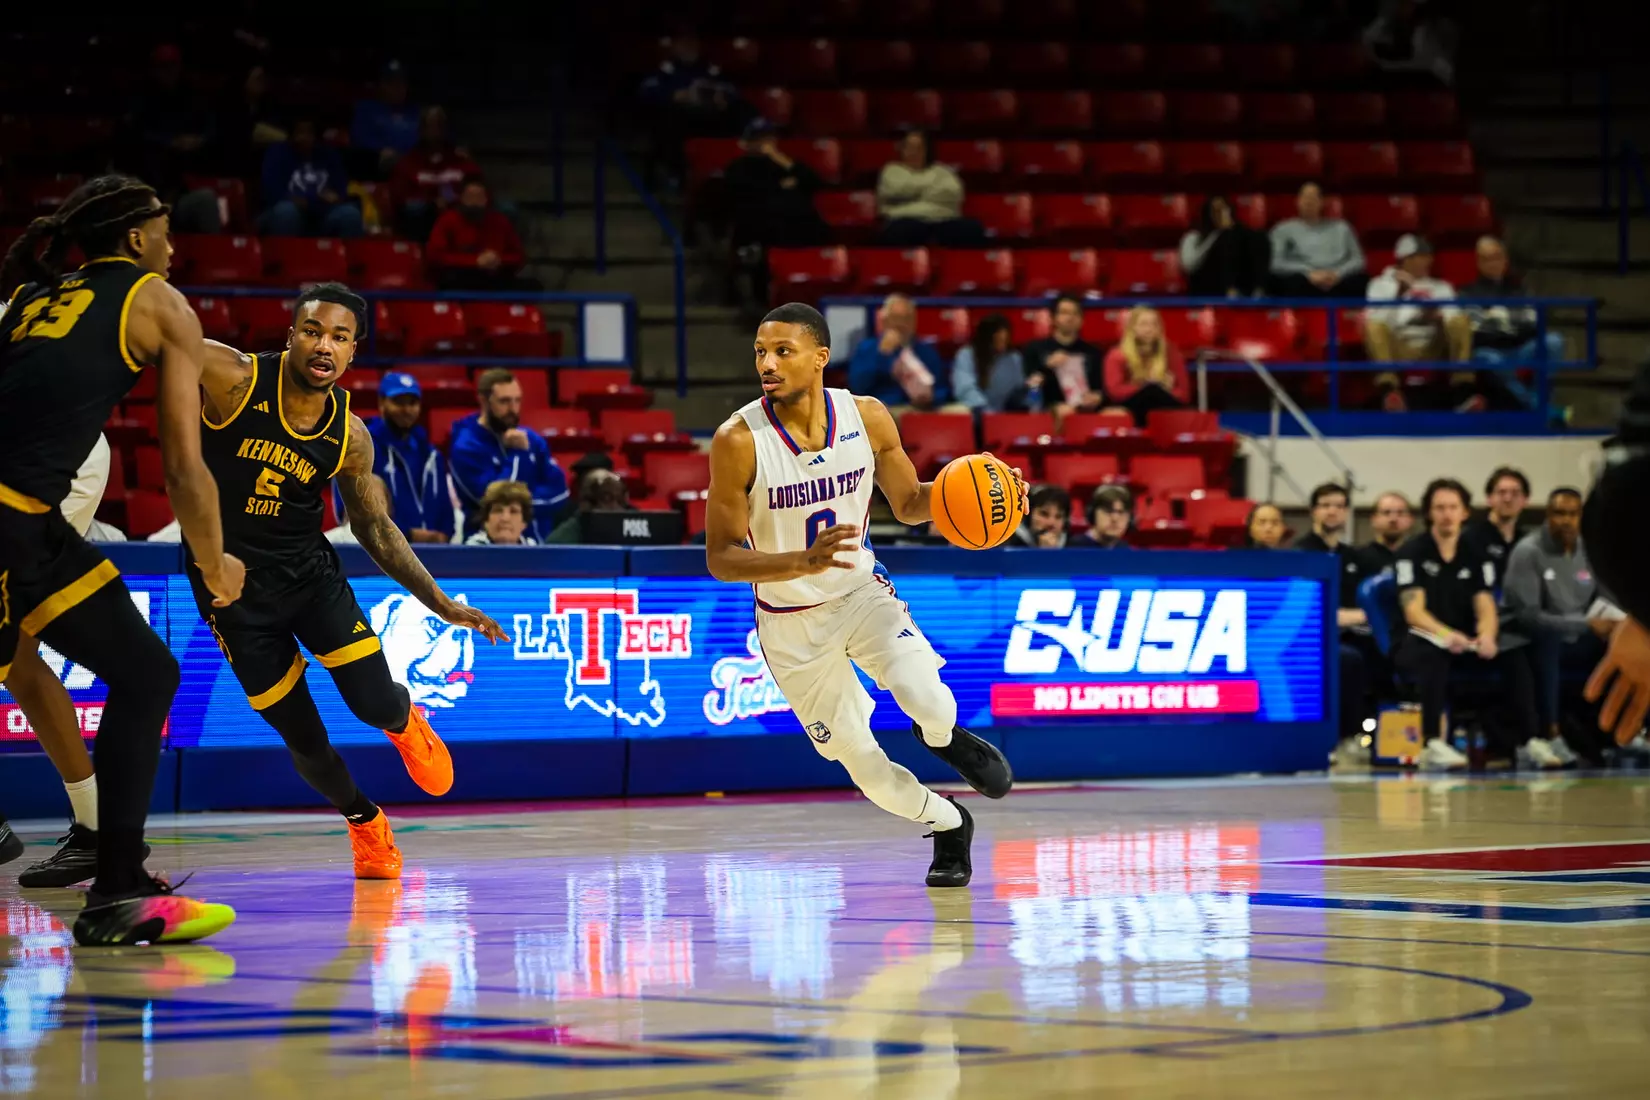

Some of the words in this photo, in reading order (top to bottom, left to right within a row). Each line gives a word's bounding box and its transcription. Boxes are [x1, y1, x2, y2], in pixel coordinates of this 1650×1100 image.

[236, 438, 318, 484] KENNESAW
[255, 467, 286, 498] 5
[768, 476, 836, 510] LOUISIANA
[984, 463, 1006, 526] Wilson
[245, 497, 283, 517] STATE
[513, 613, 570, 660] LA
[550, 588, 692, 685] TECH
[1034, 687, 1068, 711] NO
[1070, 685, 1150, 710] LIMITS
[1152, 685, 1184, 709] ON
[1187, 684, 1219, 708] US
